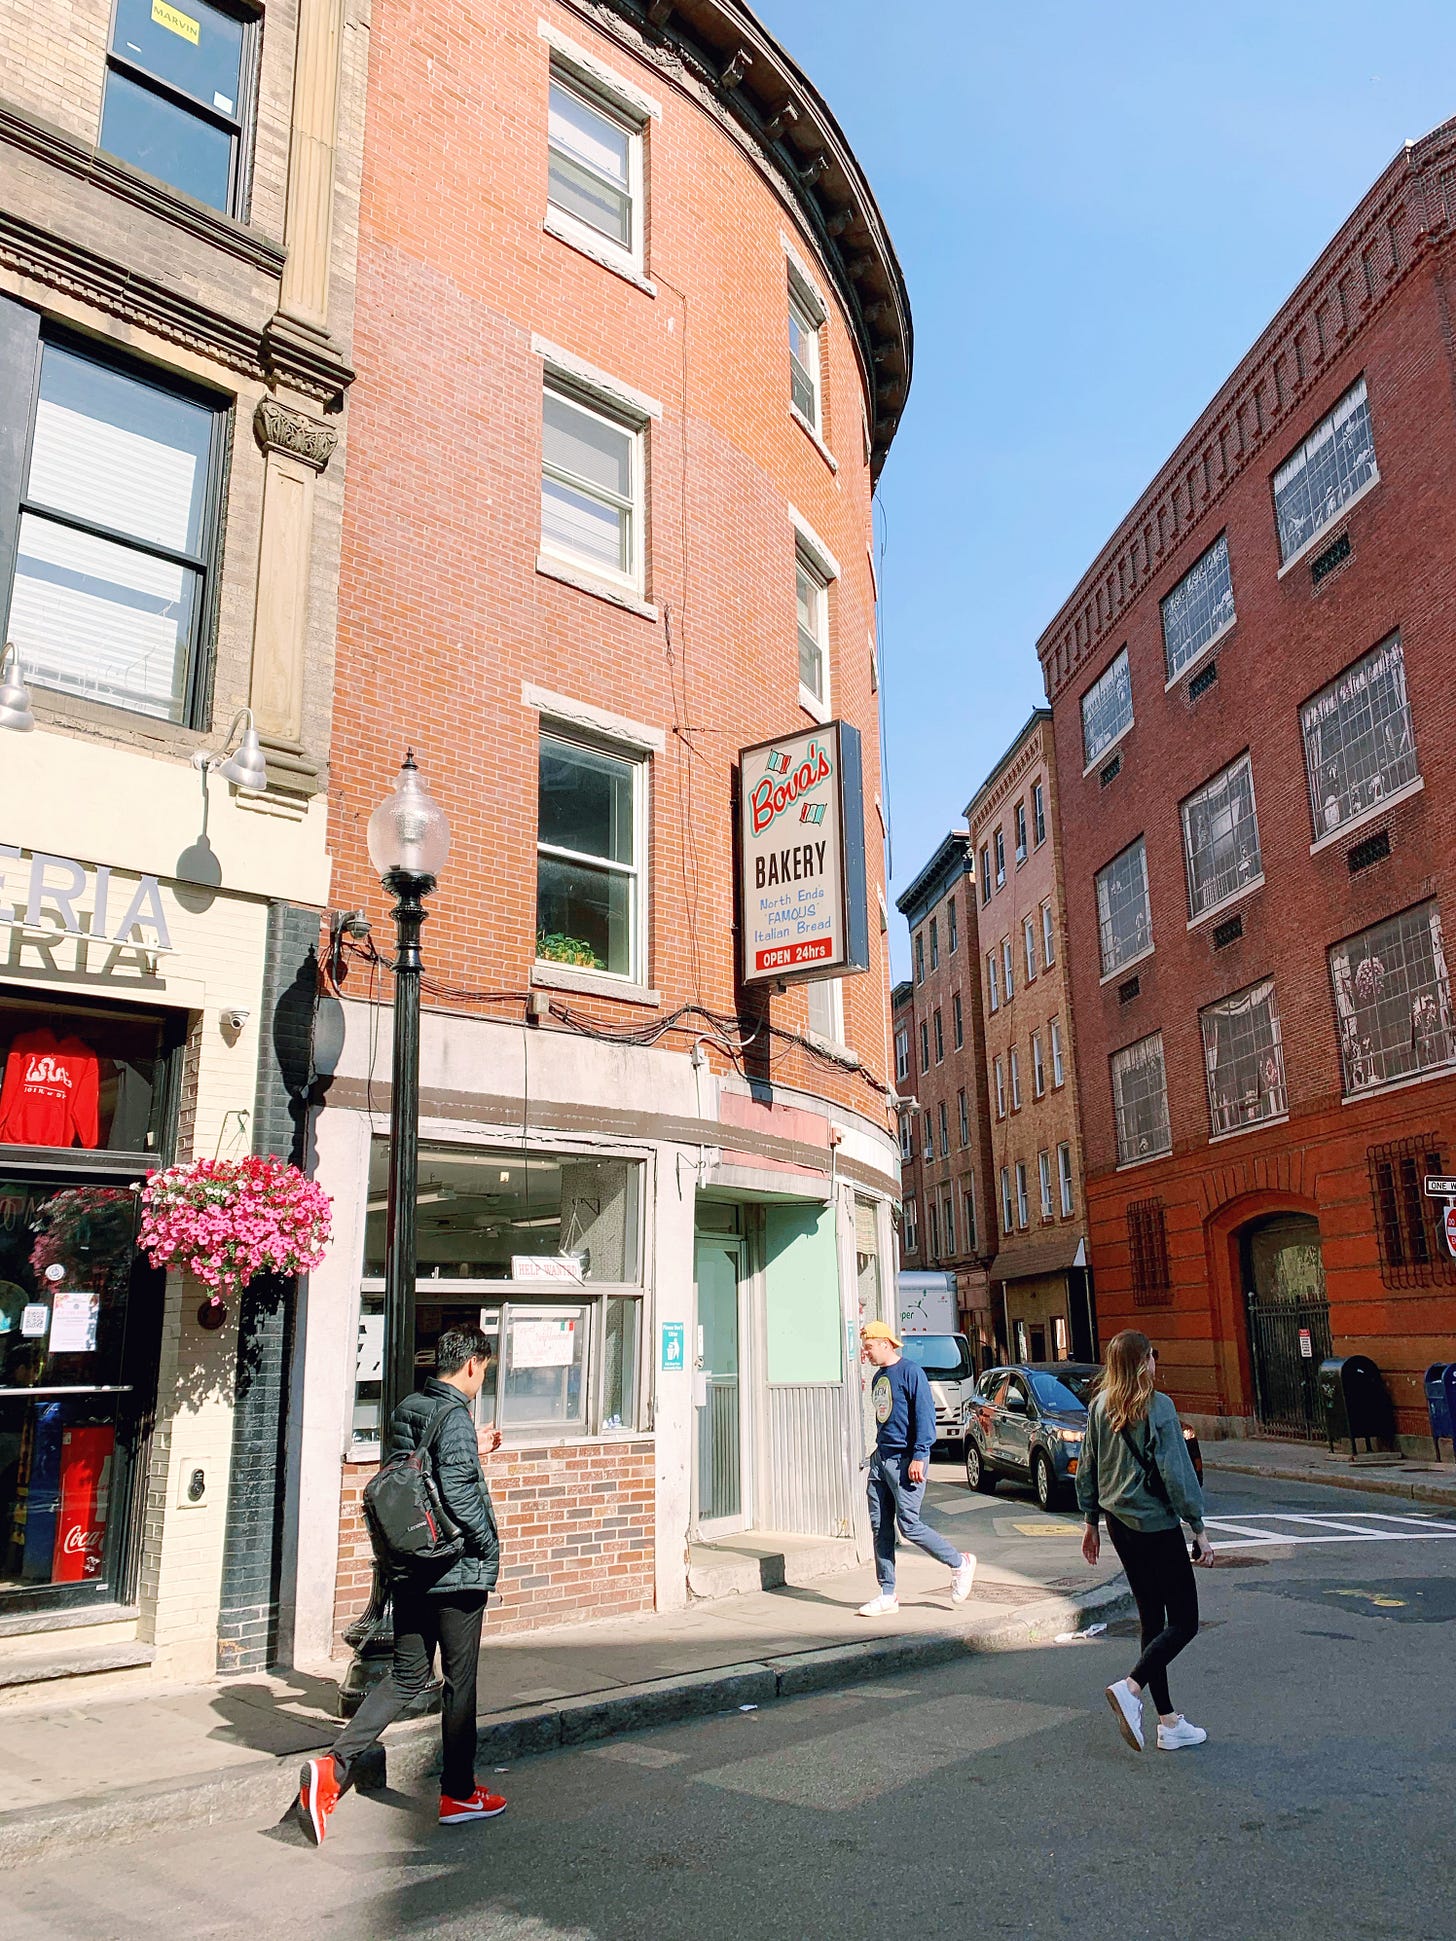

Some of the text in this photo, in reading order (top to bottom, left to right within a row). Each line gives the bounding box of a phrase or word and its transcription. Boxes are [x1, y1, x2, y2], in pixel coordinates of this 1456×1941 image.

[154, 6, 197, 36] MARVIN
[749, 741, 832, 836] Bova's
[756, 840, 826, 889] BAKERY
[760, 887, 824, 911] North Ends
[755, 916, 831, 942] Italian Bread
[763, 944, 826, 967] OPEN 24hrs
[1431, 1182, 1447, 1190] ONE
[518, 1263, 577, 1277] HELP WANTED
[900, 1311, 914, 1322] per
